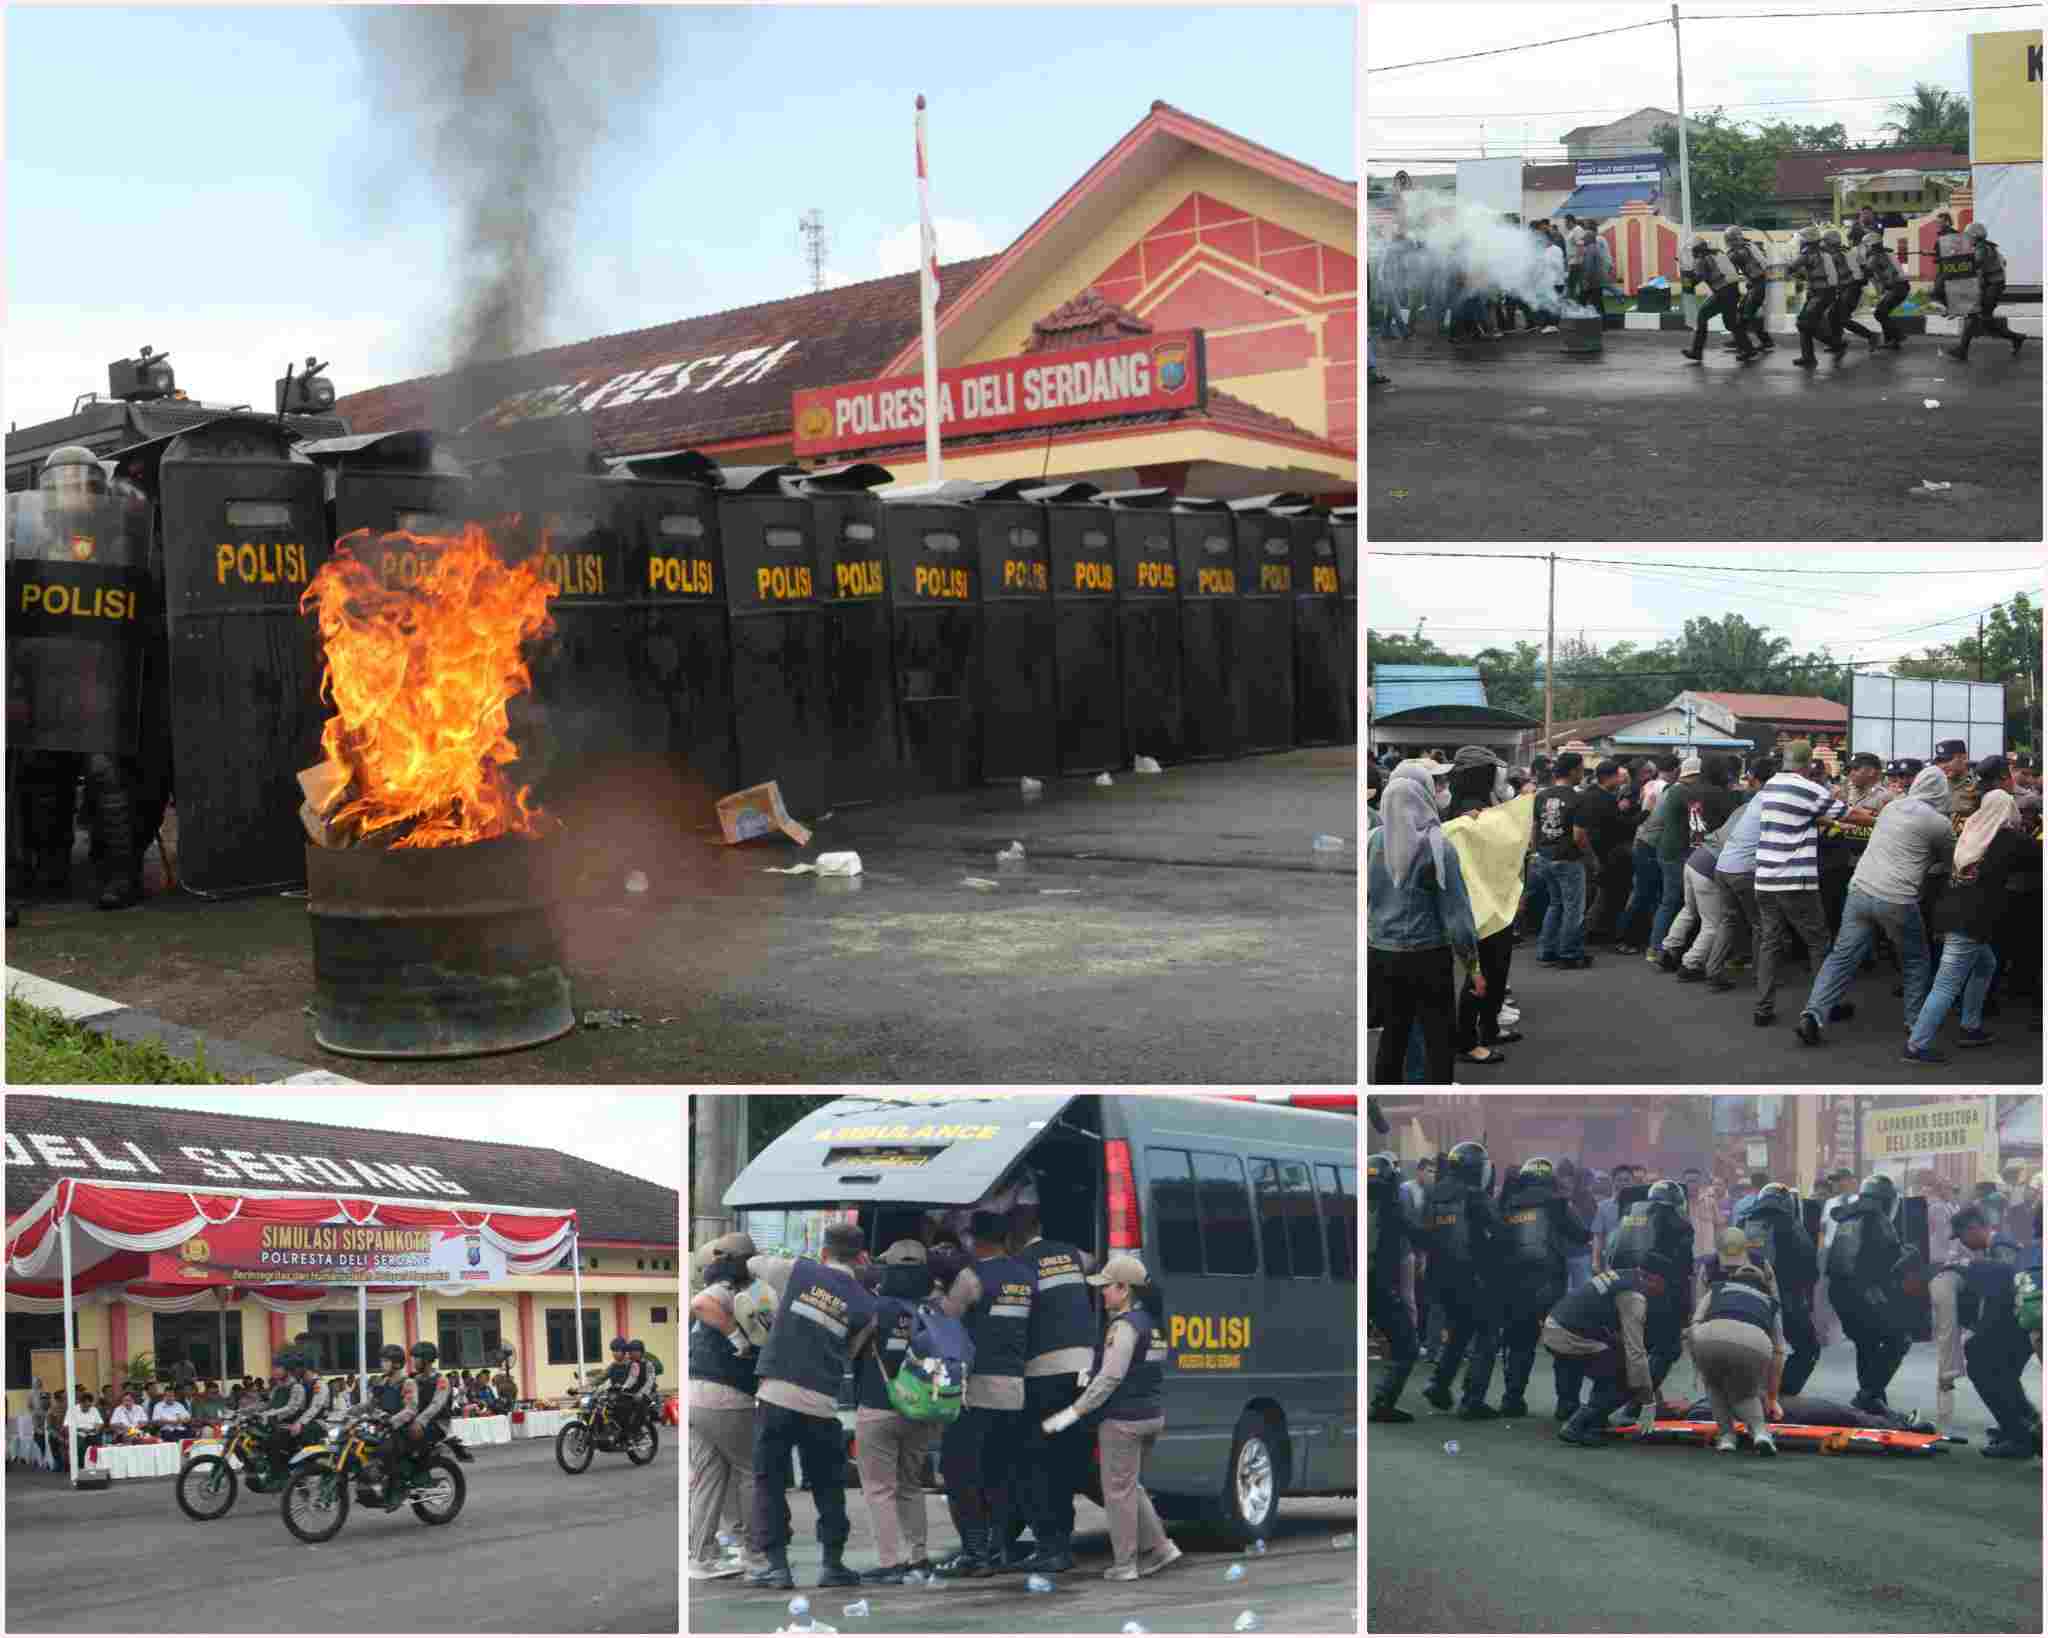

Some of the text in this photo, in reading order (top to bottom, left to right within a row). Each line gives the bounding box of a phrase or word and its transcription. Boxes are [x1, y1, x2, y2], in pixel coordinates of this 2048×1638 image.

[834, 352, 1152, 438] POLRESA DELI SERDANG
[216, 543, 307, 584] POLISI
[545, 552, 604, 593] OLISI
[649, 557, 714, 594] POLISI
[757, 565, 812, 600] POLISI
[914, 566, 968, 599] POLISI
[20, 584, 136, 619] POLISI
[179, 1145, 472, 1197] SERDANG
[261, 1225, 338, 1252] SIMULASI
[261, 1251, 333, 1265] POLRESTA
[338, 1253, 369, 1266] DELI
[1169, 1314, 1250, 1350] POLISI
